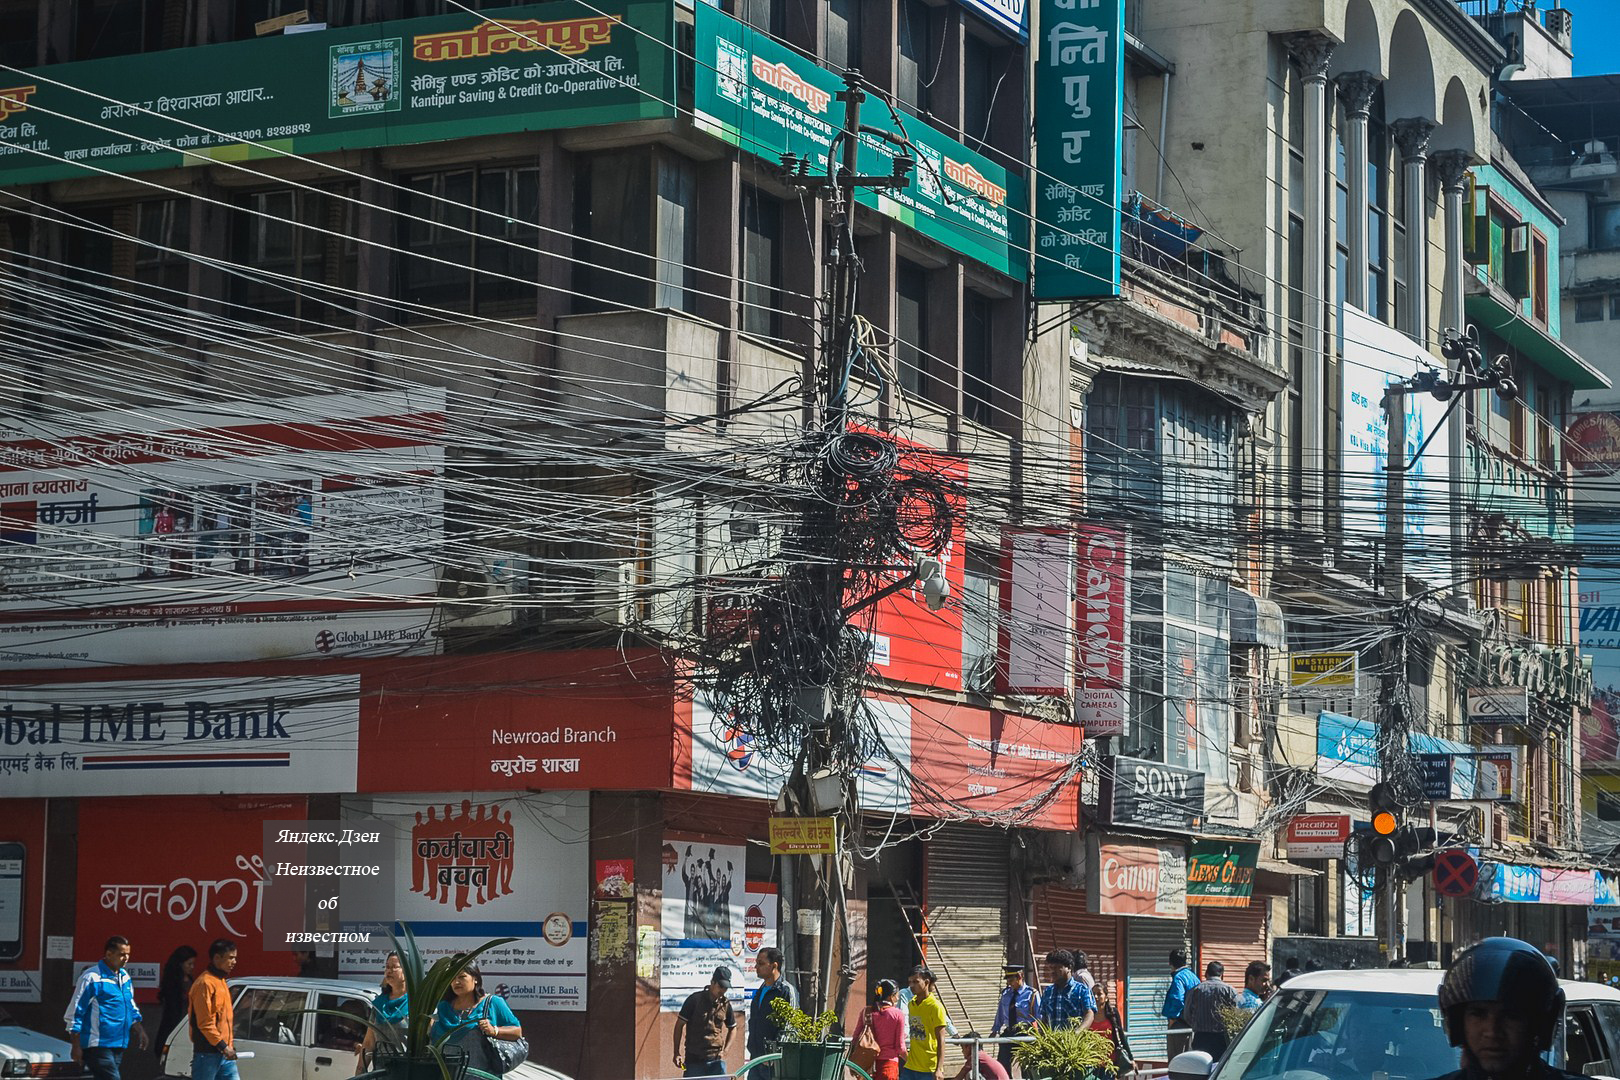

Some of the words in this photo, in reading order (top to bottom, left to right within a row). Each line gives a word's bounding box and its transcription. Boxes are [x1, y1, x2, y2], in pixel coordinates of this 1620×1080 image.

[413, 15, 621, 62] कान्तिपुर
[451, 72, 477, 87] एण्ड
[482, 66, 520, 85] क्रेडिट
[605, 55, 625, 71] लि.
[411, 92, 456, 109] Kantipur
[459, 90, 495, 105] Saving
[498, 88, 507, 99] &
[509, 83, 542, 98] Credit
[545, 77, 617, 95] Co-Operative
[619, 74, 640, 88] Ltd.
[752, 55, 831, 114] कान्तिपुर
[752, 101, 770, 118] Kantipur
[771, 110, 785, 128] Saving
[790, 119, 803, 134] Credit
[21, 122, 38, 137] लि.
[33, 139, 50, 151] Ltd.
[64, 149, 88, 160] शाखा
[90, 143, 132, 157] कार्यालय
[176, 135, 198, 148] फोन
[944, 156, 1007, 208] कान्तिपुर
[1057, 208, 1091, 223] क्रेडिट
[1065, 255, 1082, 269] लि.
[1086, 534, 1117, 678] Canon
[1579, 592, 1600, 603] ell
[336, 631, 368, 643] Global
[373, 630, 395, 640] IME
[400, 629, 426, 640] Bank
[1296, 658, 1342, 666] WESTERN
[0, 704, 61, 745] bal
[79, 703, 167, 743] IME
[183, 700, 291, 741] Bank
[492, 728, 560, 745] Newroad
[564, 726, 616, 743] Branch
[60, 752, 79, 771] लि.
[542, 758, 580, 773] शाखा
[1135, 766, 1188, 798] SONY
[416, 832, 512, 860] कर्मचारी
[438, 865, 489, 887] बचत
[1103, 858, 1157, 892] Canon
[100, 884, 166, 915] बचत
[744, 917, 766, 925] SUPER
[10, 978, 32, 987] Bank
[138, 968, 156, 977] Bank
[511, 985, 536, 995] Global
[539, 986, 556, 994] IME
[559, 986, 579, 994] Bank
